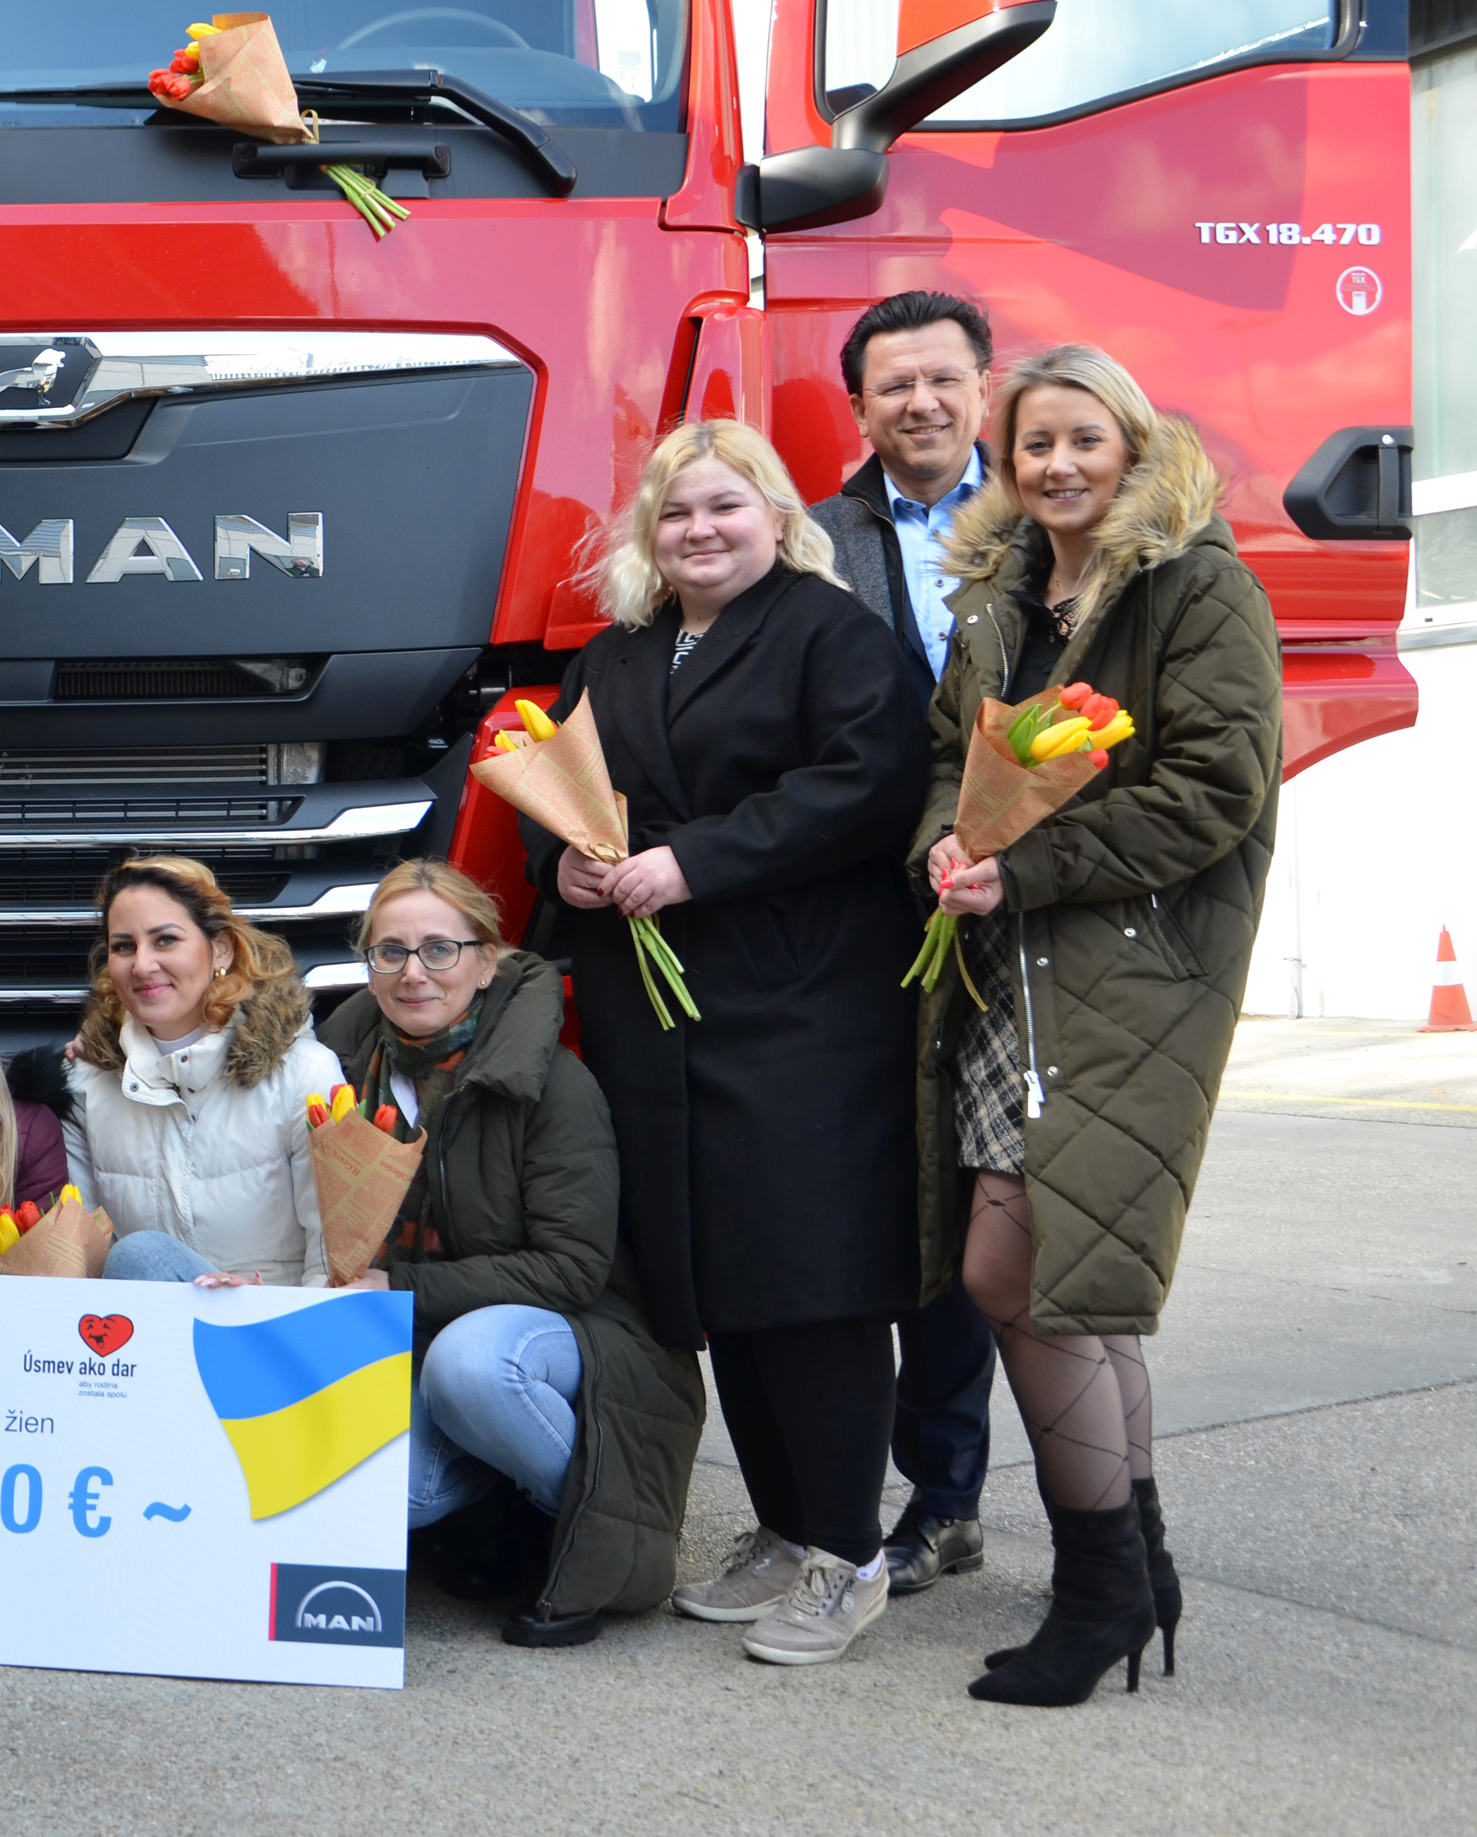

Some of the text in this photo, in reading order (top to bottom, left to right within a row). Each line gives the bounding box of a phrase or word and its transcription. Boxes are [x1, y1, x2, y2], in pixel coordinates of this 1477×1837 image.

[1195, 222, 1381, 245] TGX 18.470
[24, 1349, 137, 1377] Úsmev ako dar
[78, 1381, 118, 1389] aby rodina
[106, 1391, 128, 1399] spolu
[4, 1409, 55, 1435] žien
[68, 1466, 114, 1538] €
[304, 1612, 374, 1632] MAN
